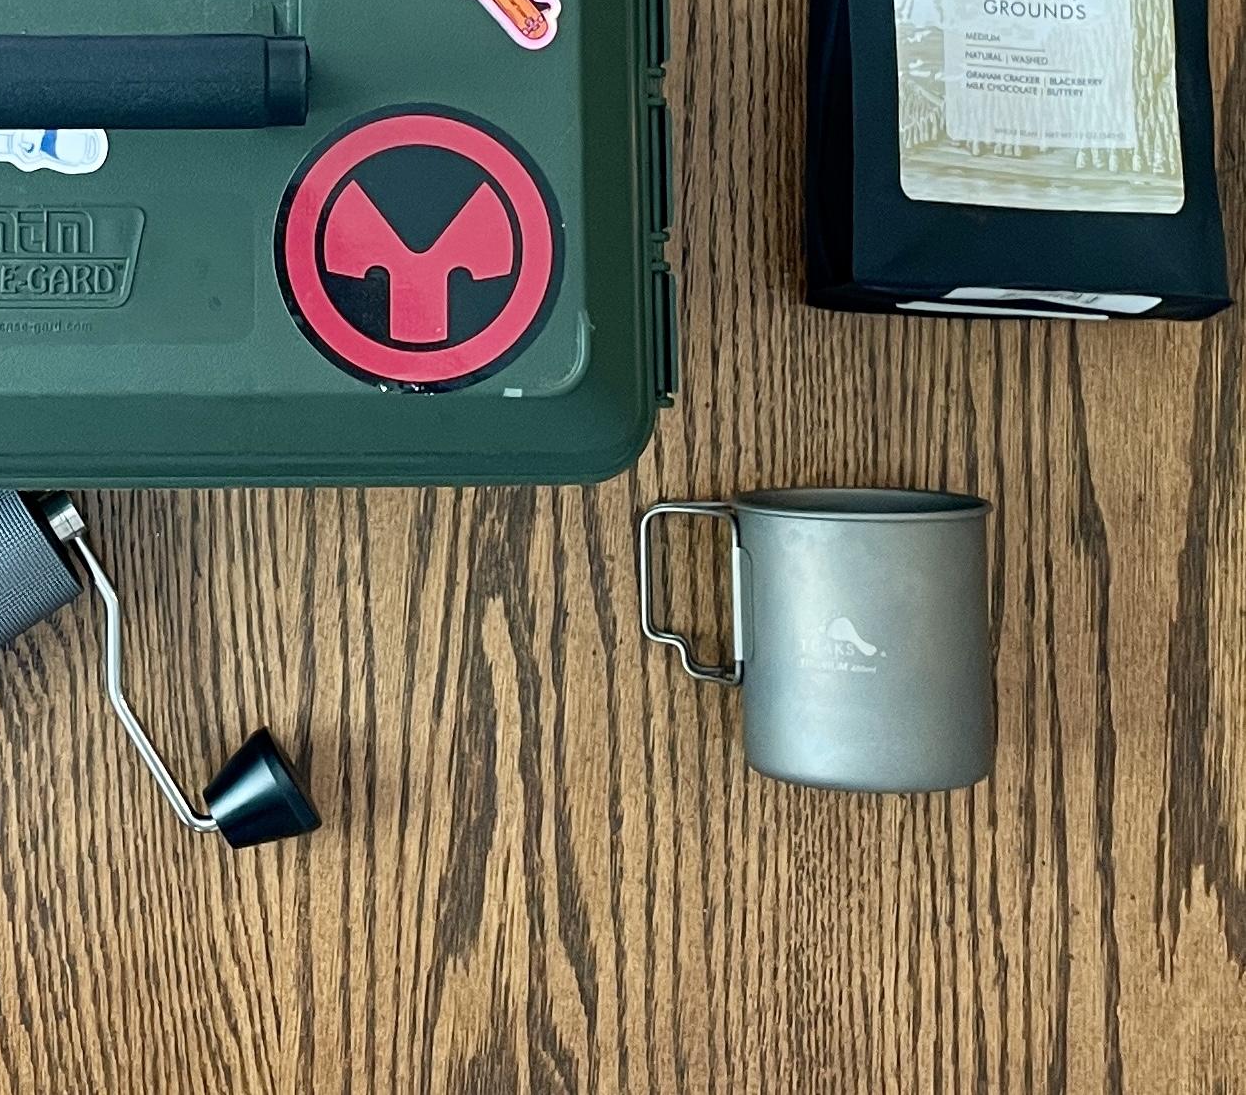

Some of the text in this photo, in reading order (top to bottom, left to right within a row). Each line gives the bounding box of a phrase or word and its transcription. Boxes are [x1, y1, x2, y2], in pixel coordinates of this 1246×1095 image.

[965, 32, 1001, 42] MEDIUM
[965, 51, 1049, 66] NATURAL WASHED
[966, 70, 1103, 86] GRAHAM CRACKER BLACKBERRY
[966, 82, 1084, 97] MILK CHOCOLATE BUTTERY
